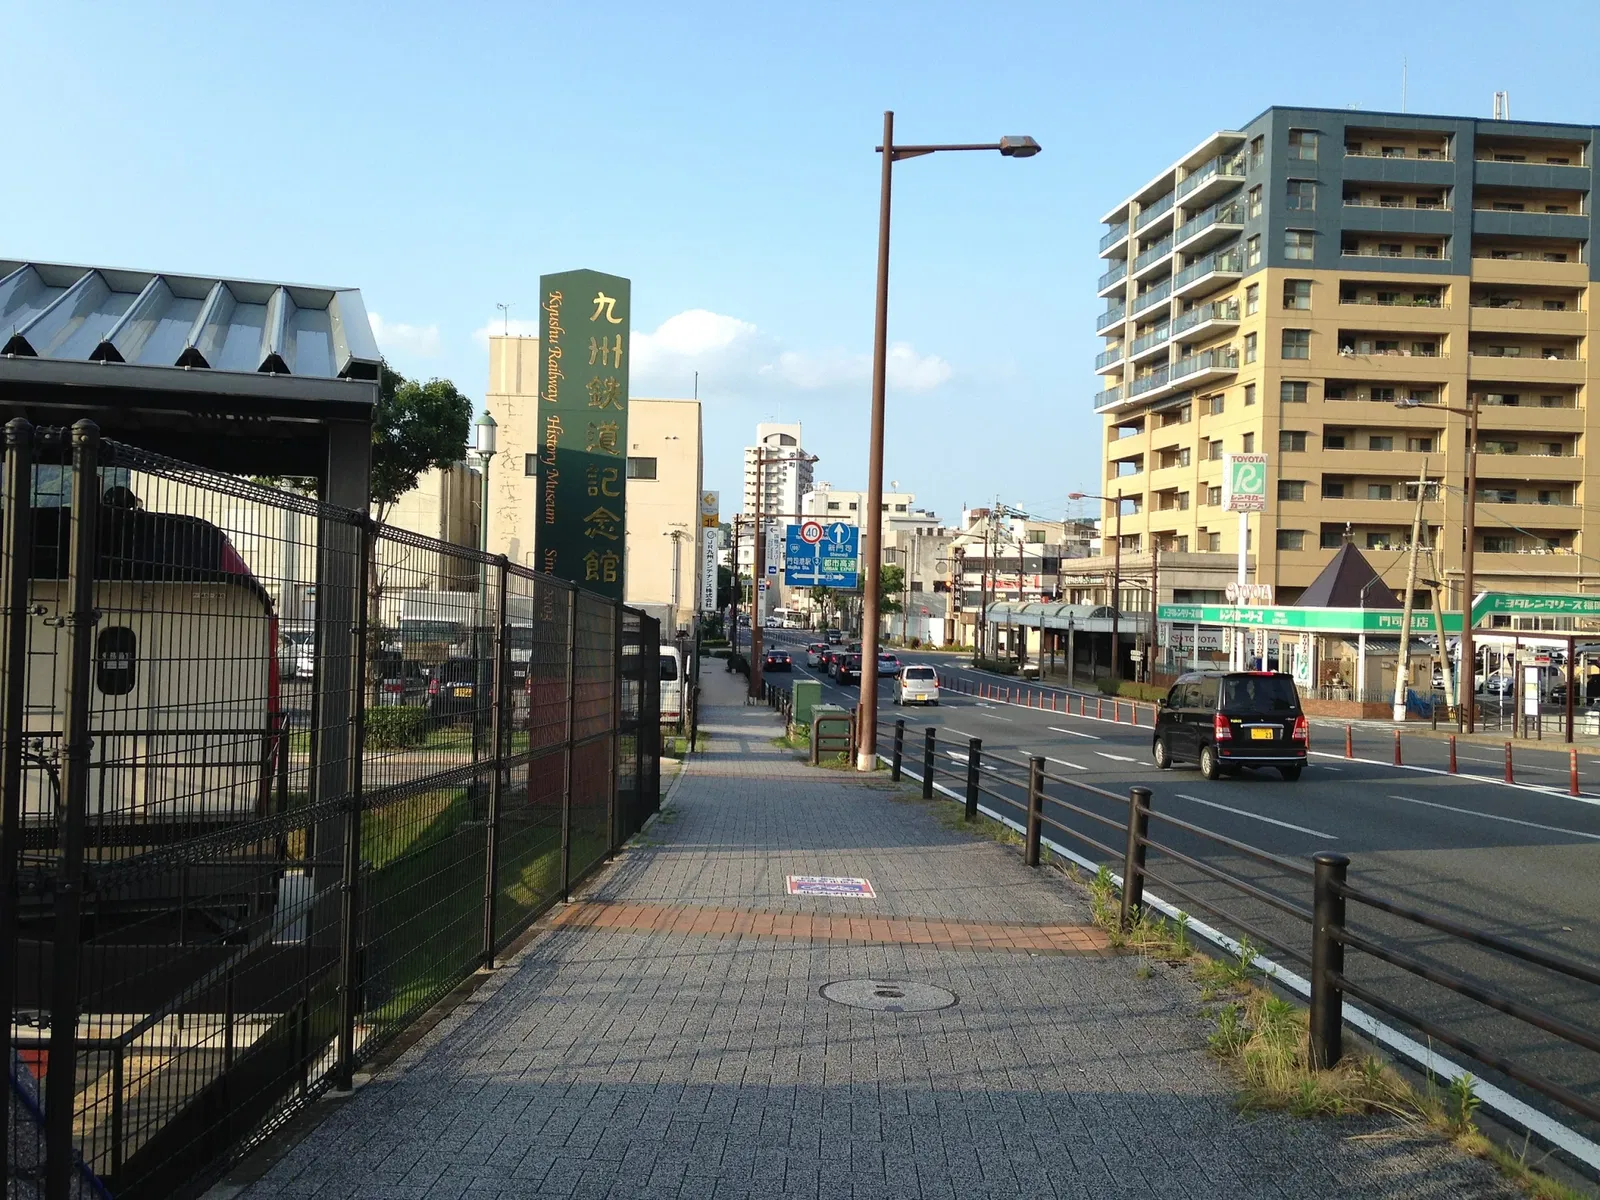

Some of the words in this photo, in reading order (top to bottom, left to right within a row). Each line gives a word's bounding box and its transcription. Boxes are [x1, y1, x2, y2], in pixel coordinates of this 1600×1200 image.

[542, 291, 566, 344] Kyushu
[541, 346, 565, 402] Railway
[539, 415, 564, 467] History
[582, 291, 625, 583] 九州鉄道記念館
[1231, 455, 1266, 463] TOYOTA
[545, 468, 562, 525] Museum
[805, 527, 818, 538] 40
[1238, 584, 1272, 600] TOYOTA
